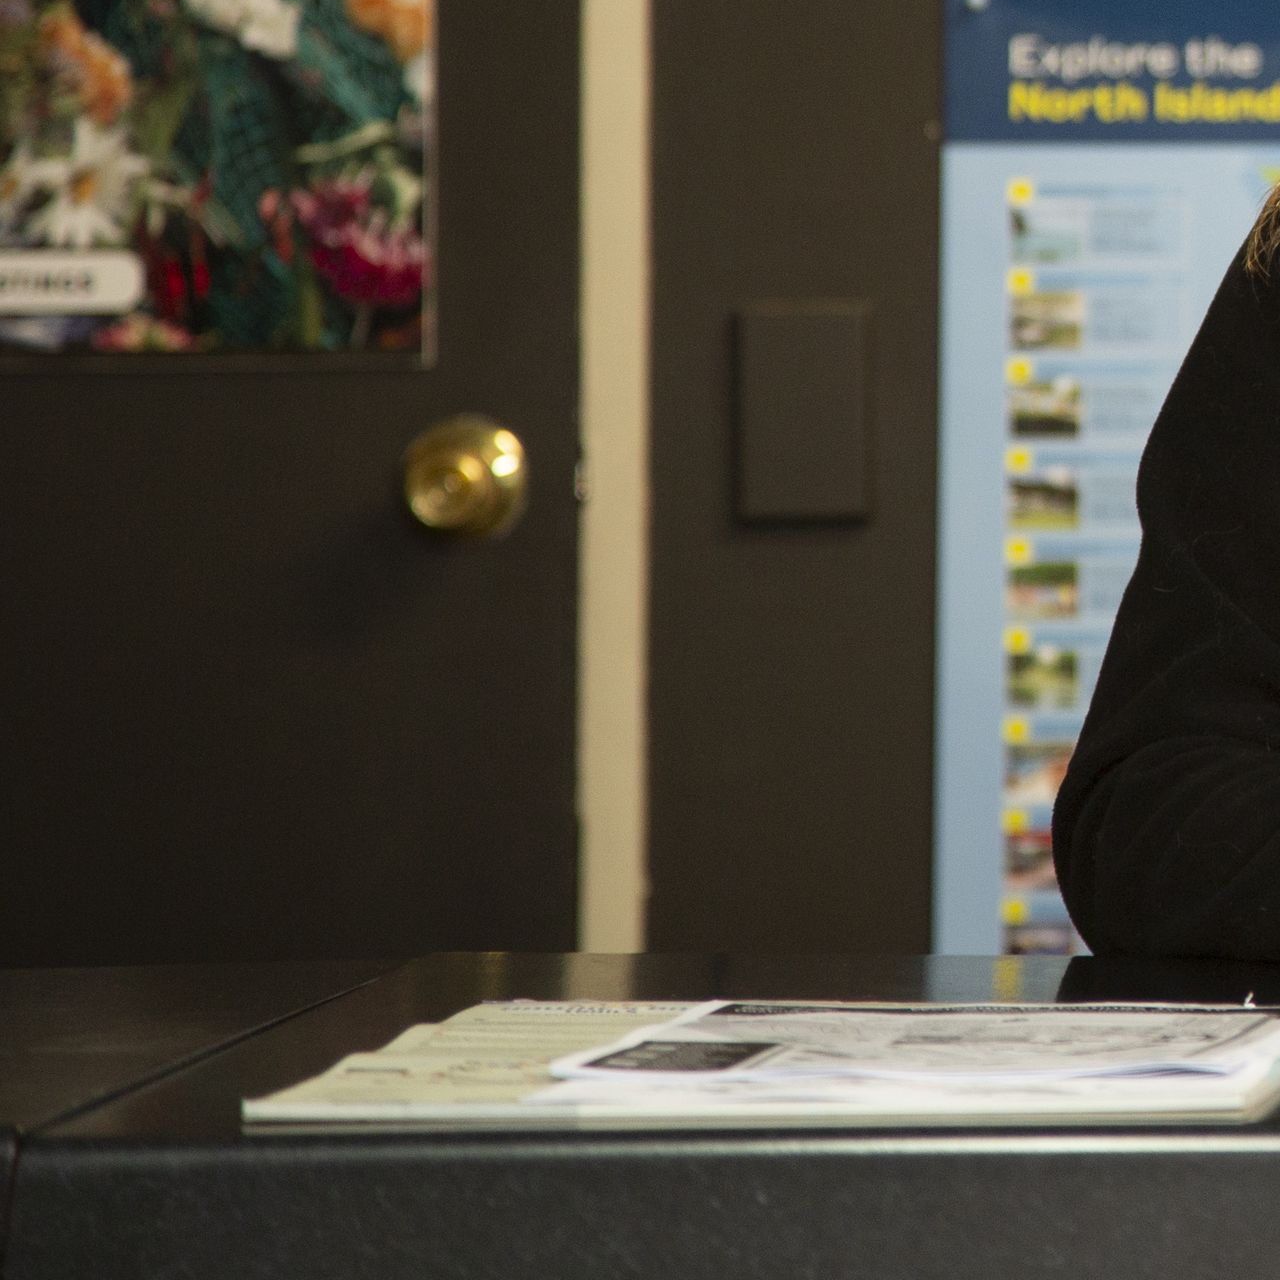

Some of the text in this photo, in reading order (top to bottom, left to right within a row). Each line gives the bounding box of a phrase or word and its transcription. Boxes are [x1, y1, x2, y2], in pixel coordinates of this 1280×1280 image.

[1008, 34, 1263, 82] Explore the
[1008, 80, 1147, 122] North
